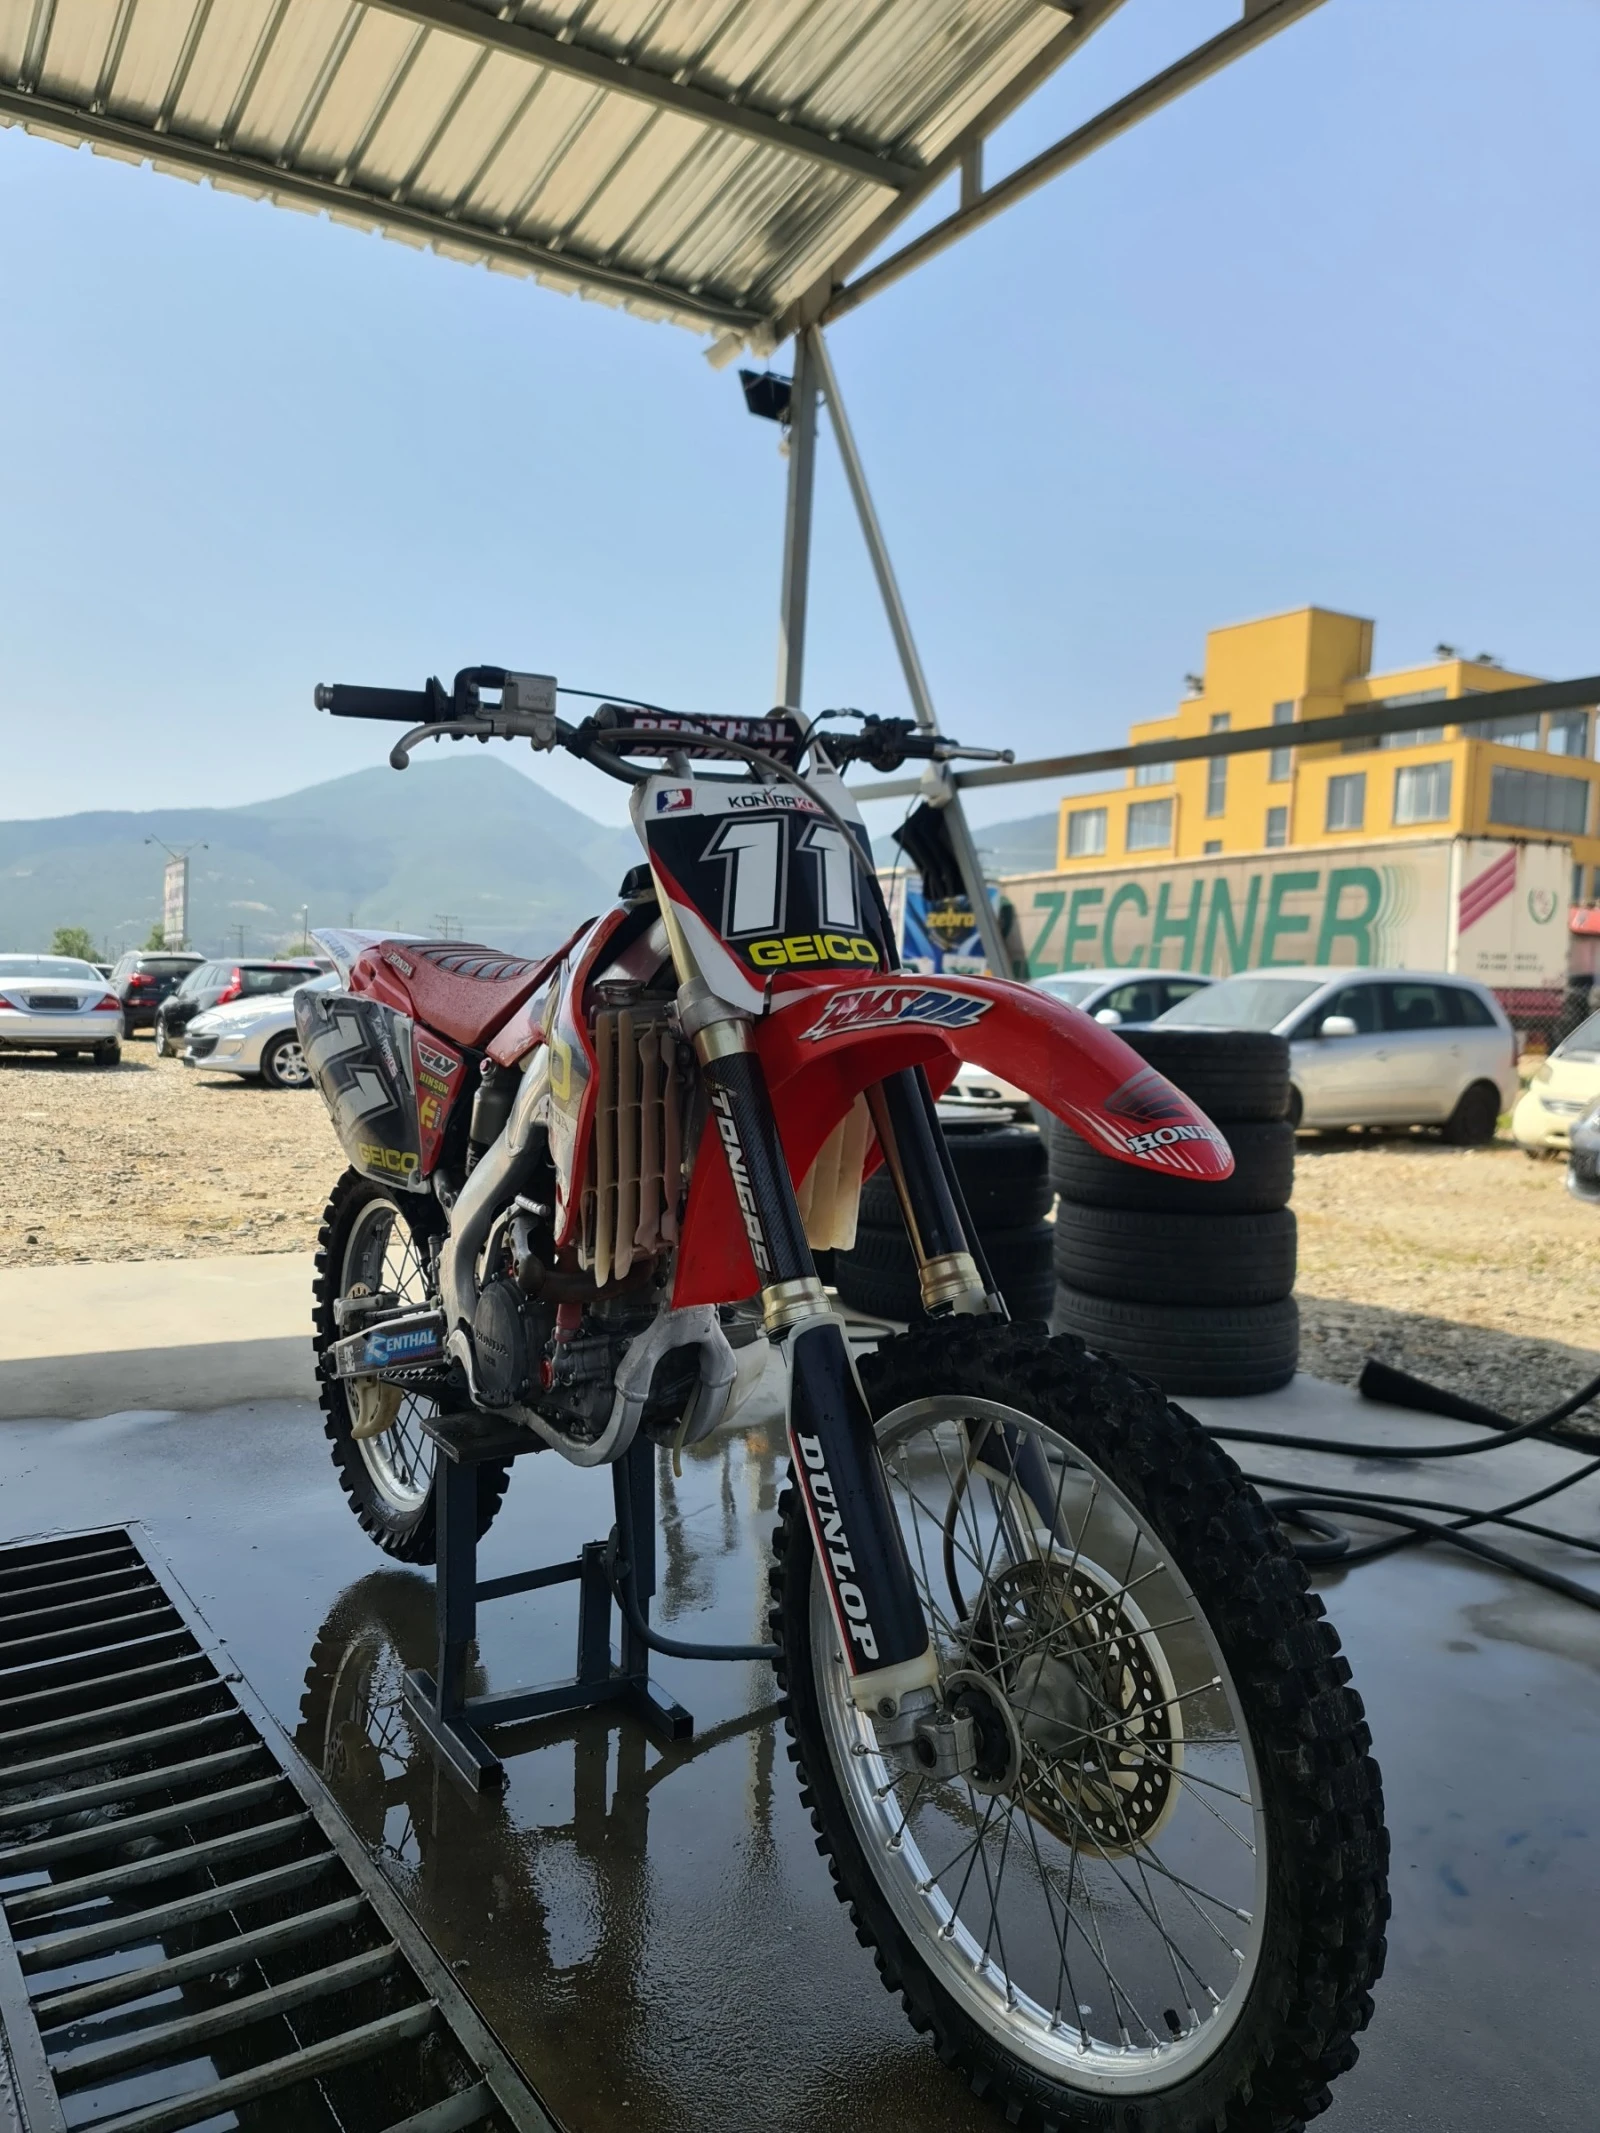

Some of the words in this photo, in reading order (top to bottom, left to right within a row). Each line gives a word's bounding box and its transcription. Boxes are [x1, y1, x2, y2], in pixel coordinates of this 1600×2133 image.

[698, 814, 864, 940] 11
[1029, 866, 1382, 978] ZECHNER
[389, 951, 414, 977] HONDA
[749, 934, 880, 966] GEICO
[807, 989, 988, 1037] AMSOIL
[417, 1050, 456, 1074] FLY
[419, 1071, 450, 1095] HINSON
[358, 1142, 420, 1174] GEICO
[797, 1432, 880, 1661] DUNLOP
